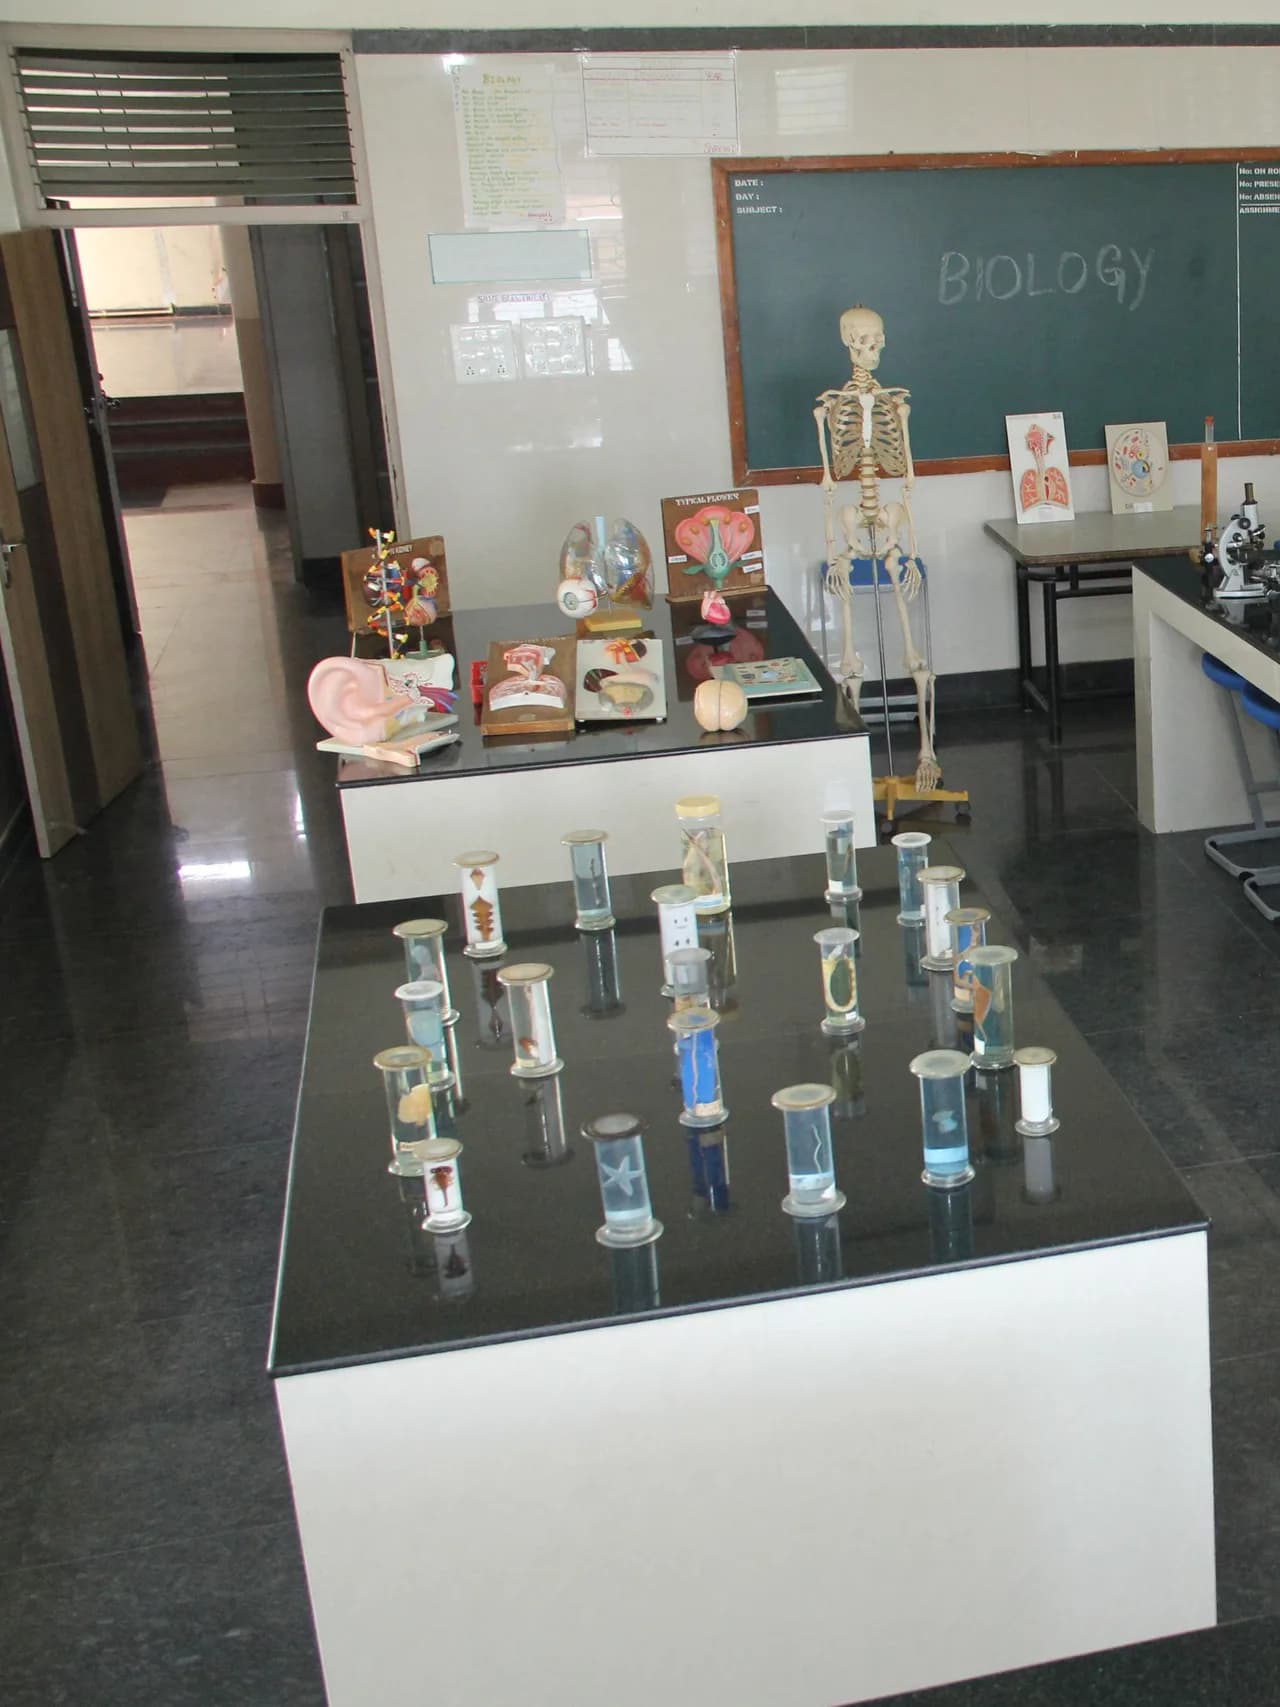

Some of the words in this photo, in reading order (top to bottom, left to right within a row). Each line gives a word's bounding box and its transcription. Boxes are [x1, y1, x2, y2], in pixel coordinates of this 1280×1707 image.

[938, 244, 1154, 311] BIOLOGY
[675, 496, 707, 506] TYPICAL
[707, 492, 740, 504] FLOWER
